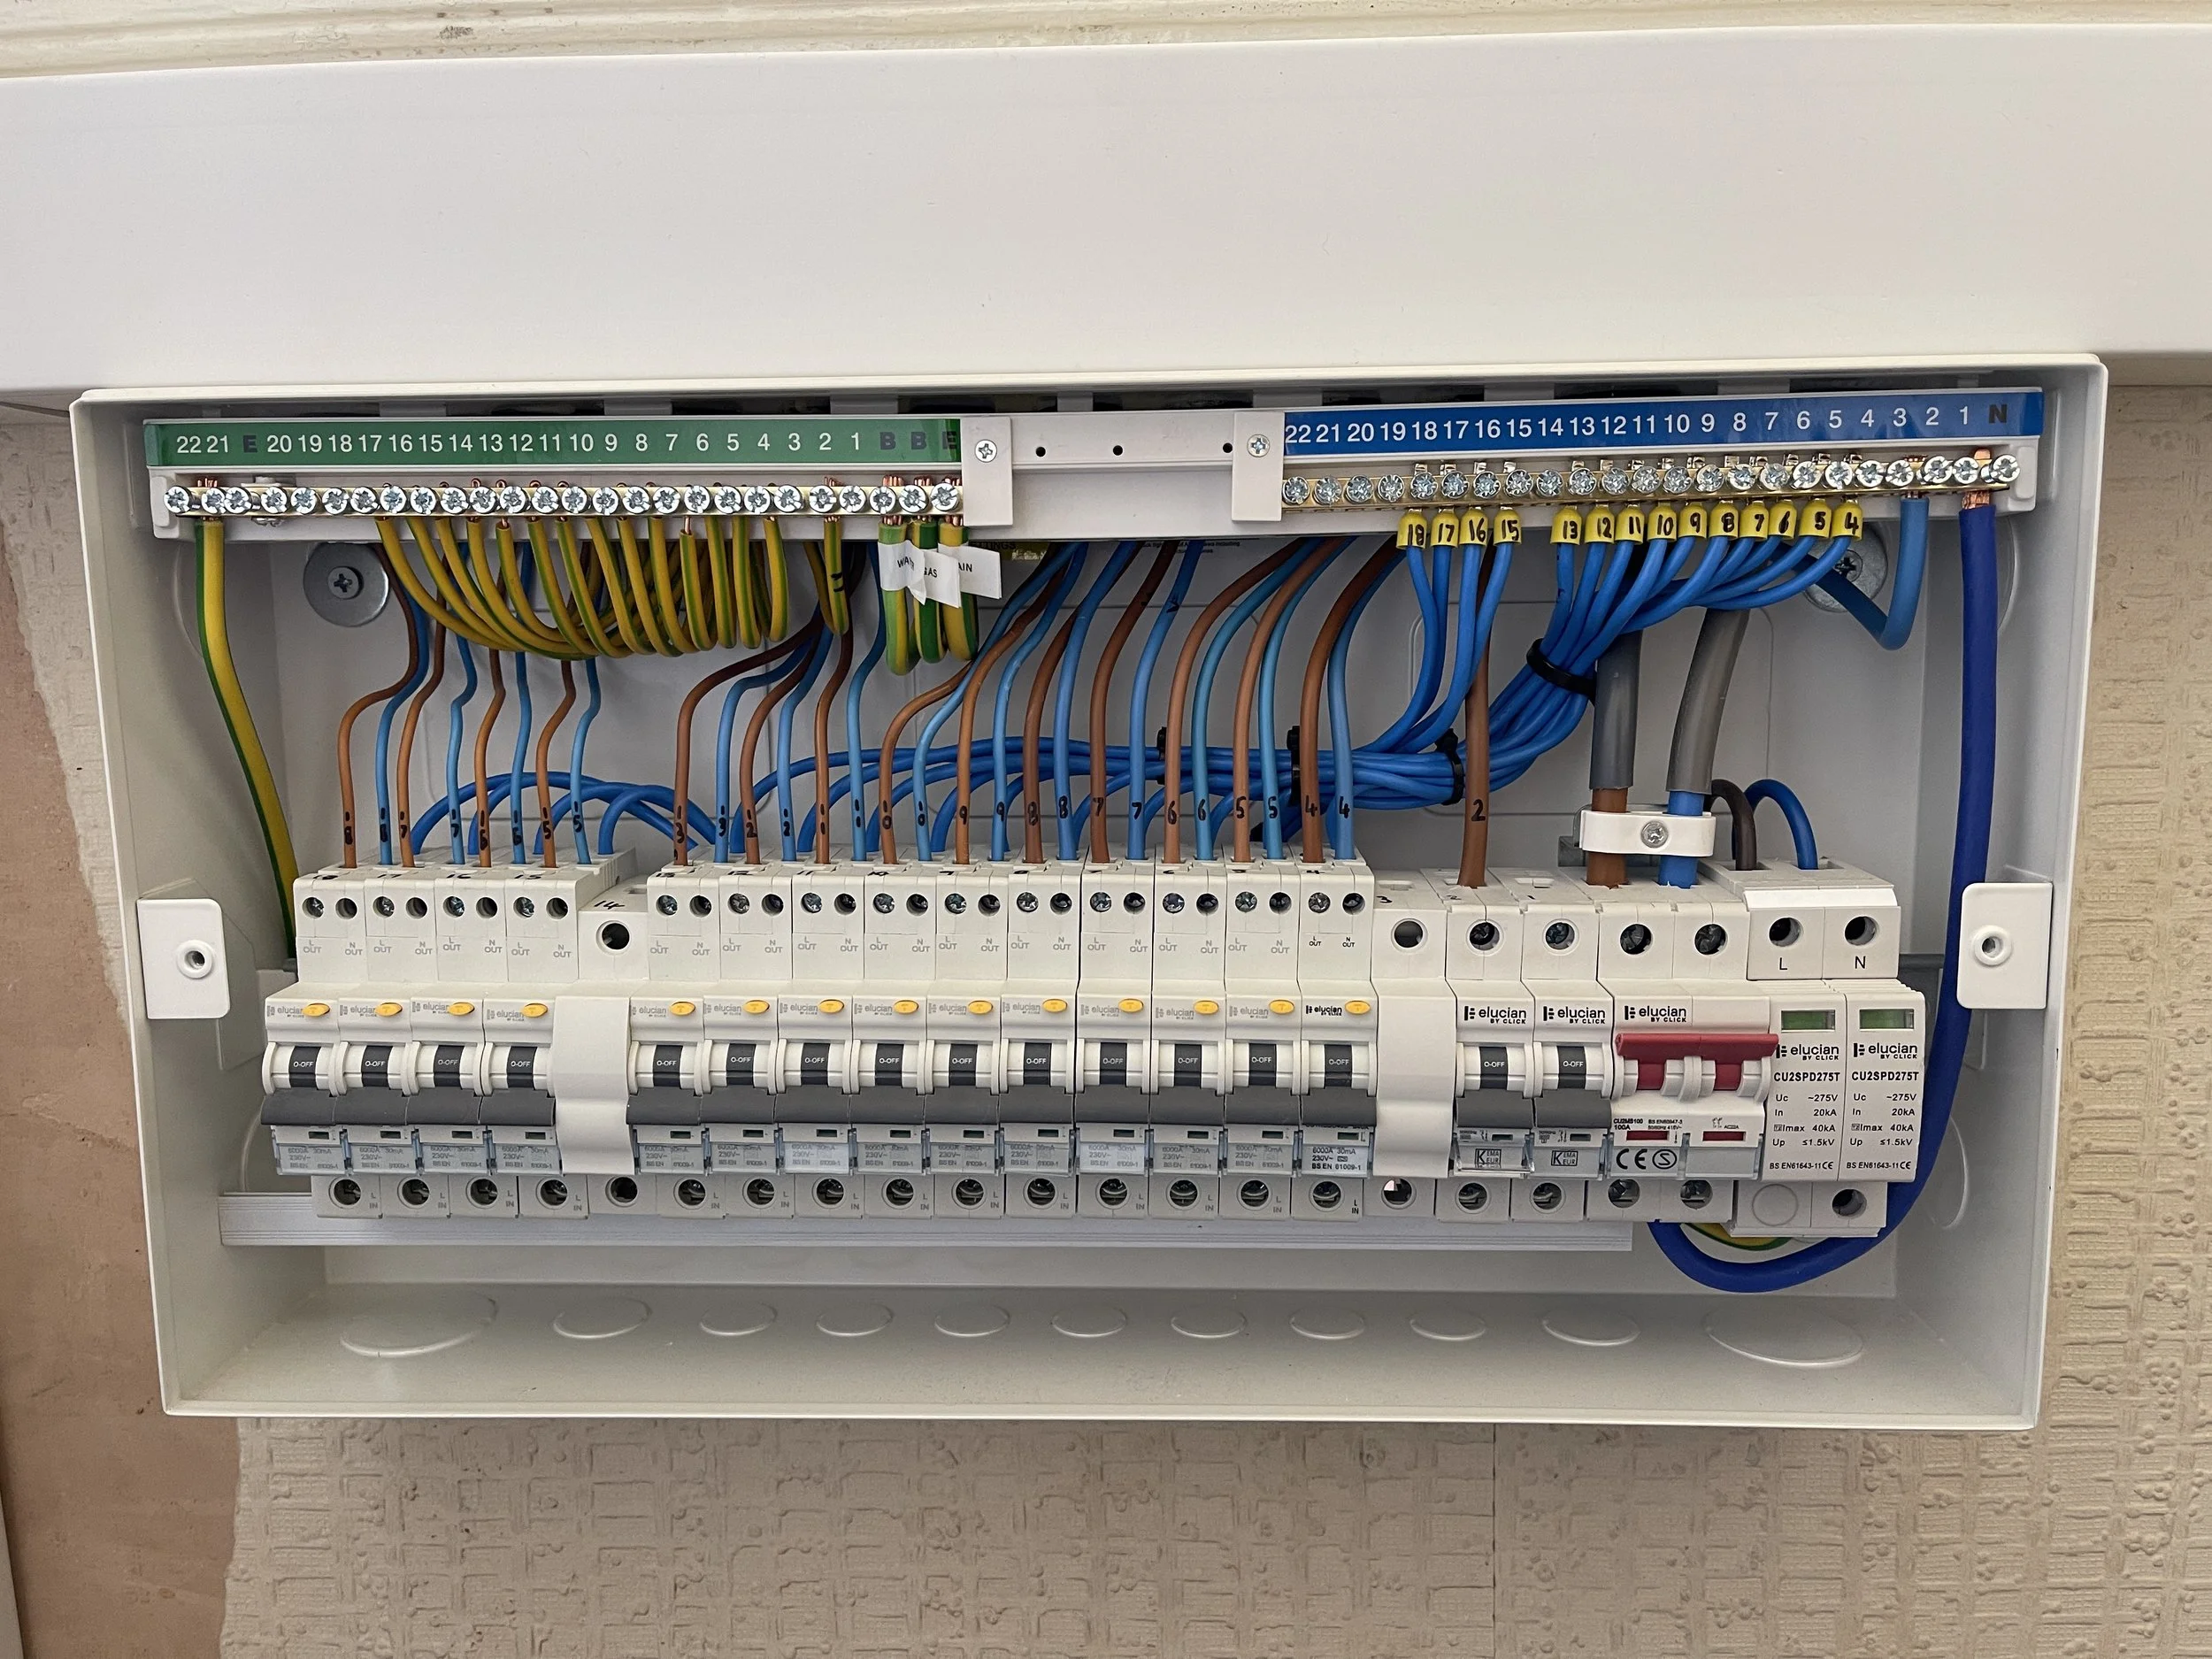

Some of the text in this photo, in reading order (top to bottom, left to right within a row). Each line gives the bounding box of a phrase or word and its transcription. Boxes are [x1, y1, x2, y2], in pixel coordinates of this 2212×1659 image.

[1286, 403, 2008, 443] 22 21 20 19 18 17 16 15 14 13 12 11 10 9 8 7 6 5 4 3 2 1 N
[176, 430, 957, 454] 22 21 E 20 19 18 17 16 15 14 13 12 11 10 9 8 7 6 5 4 3 2 1 B B E
[1469, 518, 1486, 542] 16
[1502, 518, 1519, 541] 15
[1563, 520, 1579, 541] 13
[1596, 517, 1612, 539] 12
[1629, 517, 1643, 535] 11
[1656, 514, 1674, 536] 10
[1689, 512, 1701, 533] 9
[1721, 513, 1735, 533] 8
[1754, 513, 1765, 533] 7
[1778, 511, 1790, 535] 6
[1814, 511, 1826, 531] 5
[1844, 512, 1860, 536] 4
[1438, 523, 1455, 541] 17
[996, 802, 1005, 822] 9
[1132, 802, 1144, 820] 7
[1167, 800, 1178, 825] 6
[1196, 799, 1207, 821] 6
[1235, 795, 1247, 819] 5
[1267, 795, 1279, 819] 5
[1305, 795, 1318, 818] 4
[1339, 795, 1350, 819] 4
[1471, 798, 1486, 822] 2
[593, 899, 626, 910] 14
[1778, 957, 1788, 971] L
[1855, 956, 1866, 970] N
[1479, 1006, 1527, 1018] elucian
[1557, 1006, 1606, 1018] elucian
[1639, 1005, 1686, 1017] elucian
[1790, 1044, 1839, 1056] elucian
[1868, 1042, 1918, 1055] elucian
[1773, 1071, 1840, 1082] CU2SPD275T
[1851, 1071, 1919, 1081] CU2SPD275T
[1775, 1094, 1789, 1102] Uc
[1853, 1093, 1867, 1102] Uc
[1860, 1123, 1883, 1132] Imax
[1772, 1138, 1786, 1148] Up
[1849, 1138, 1863, 1148] Up
